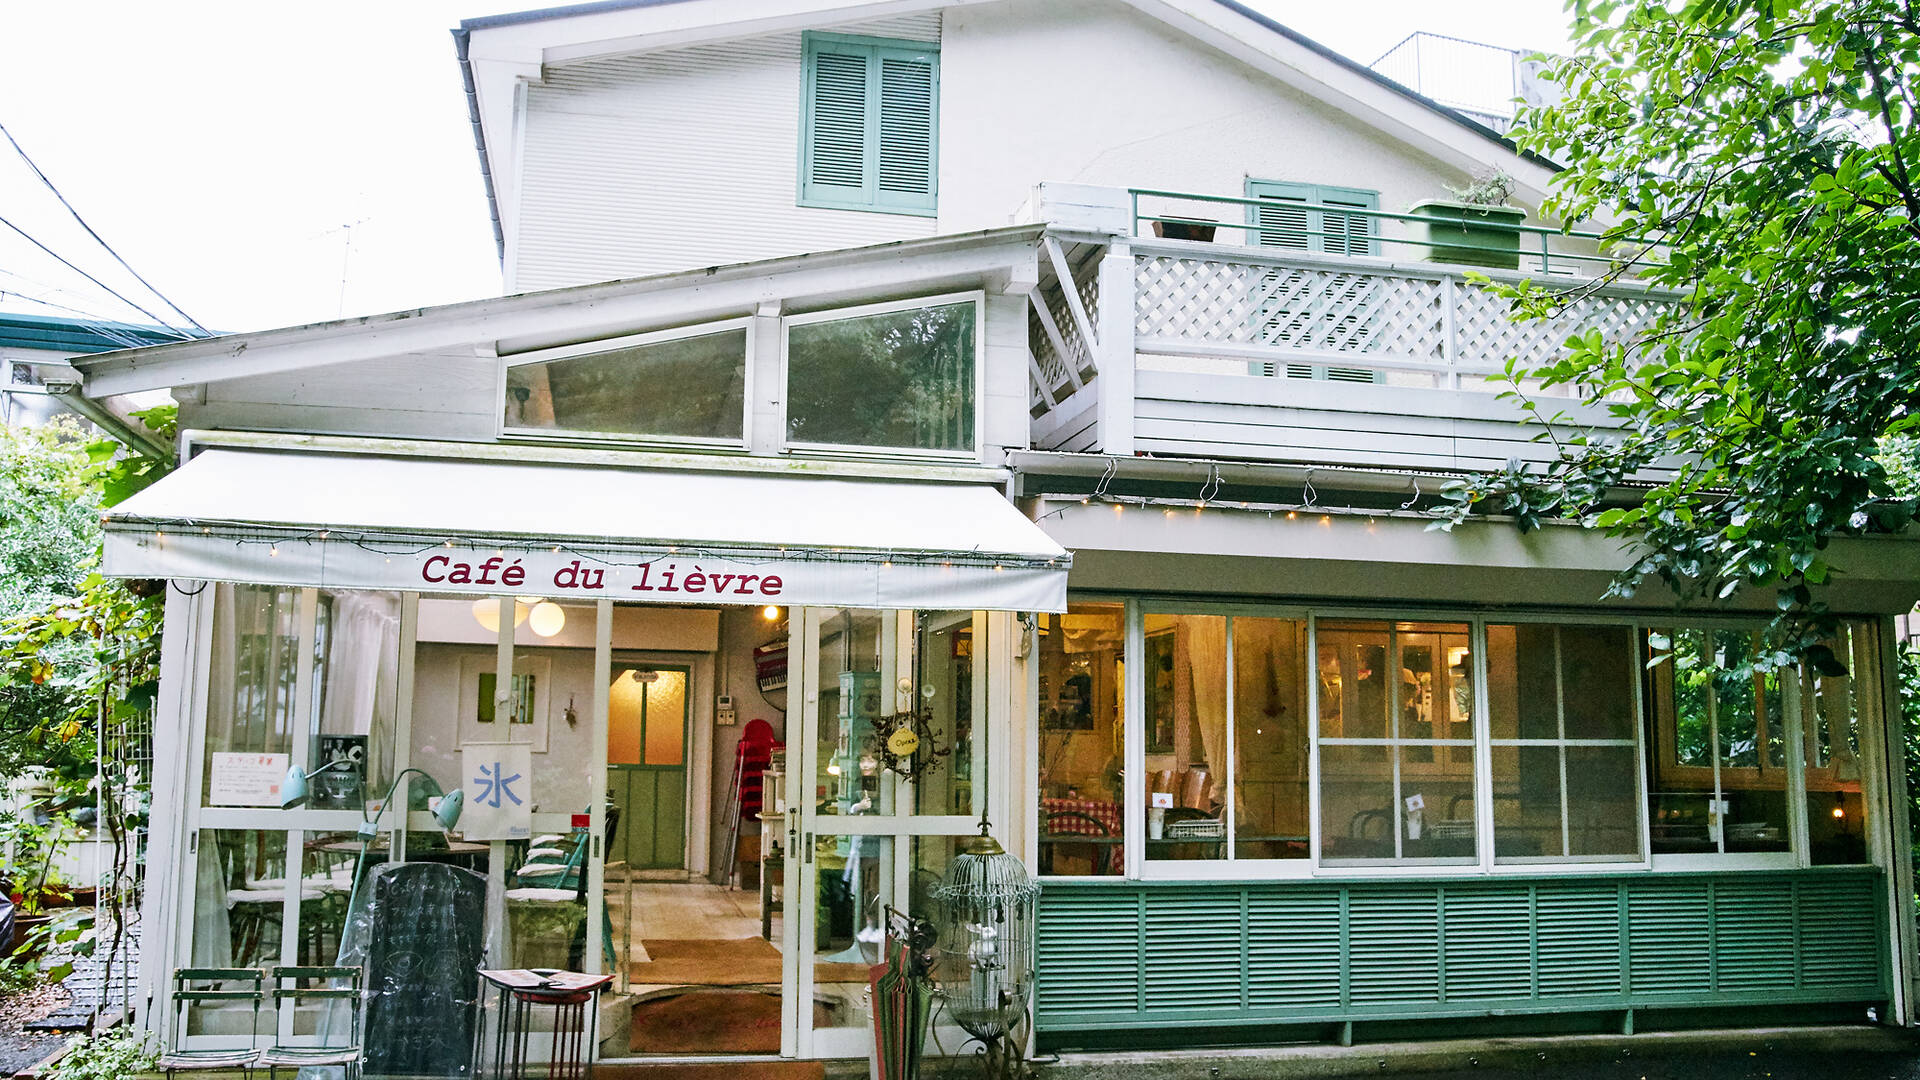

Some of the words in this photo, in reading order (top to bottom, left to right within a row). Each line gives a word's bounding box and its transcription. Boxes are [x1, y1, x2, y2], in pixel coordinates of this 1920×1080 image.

[422, 556, 526, 586] Café
[553, 560, 604, 589] du
[631, 563, 783, 596] lièvre
[473, 762, 523, 809] 氷
